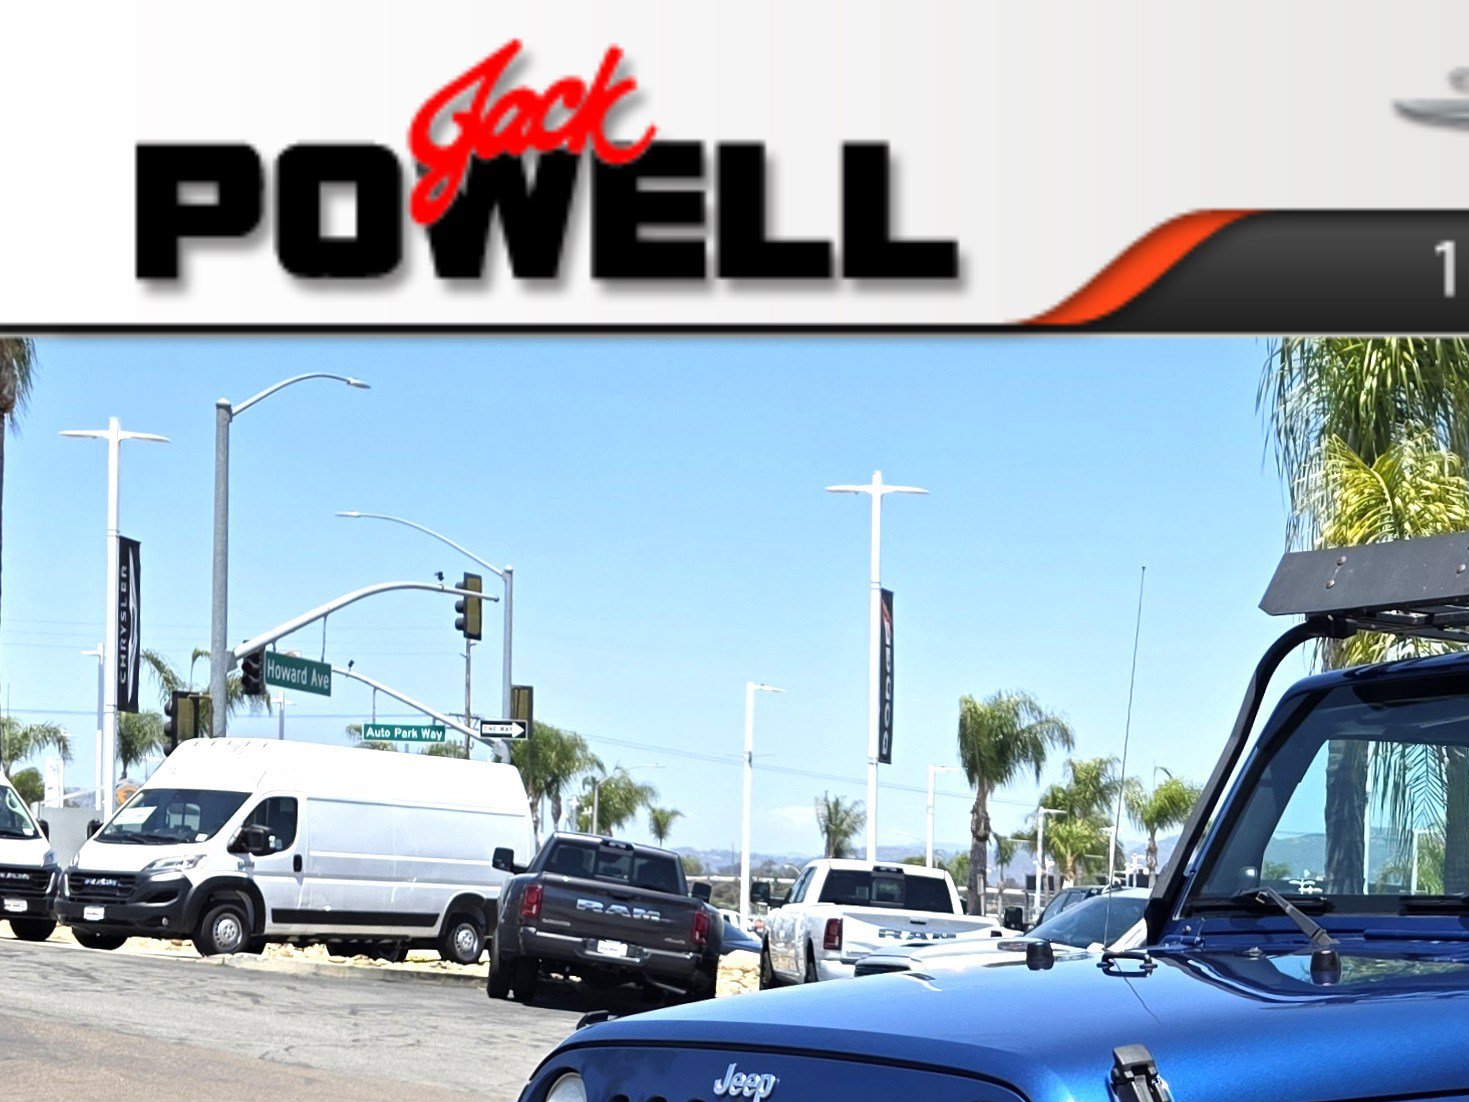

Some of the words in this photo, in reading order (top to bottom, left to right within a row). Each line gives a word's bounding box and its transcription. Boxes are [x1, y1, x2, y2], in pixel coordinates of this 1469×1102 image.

[120, 565, 128, 684] CHRYSLER
[266, 658, 308, 685] Howard
[311, 668, 330, 690] Ave
[366, 726, 391, 738] Auto
[394, 727, 418, 739] Park
[421, 728, 443, 741] Way
[576, 898, 661, 920] RAM
[878, 928, 957, 940] RAM
